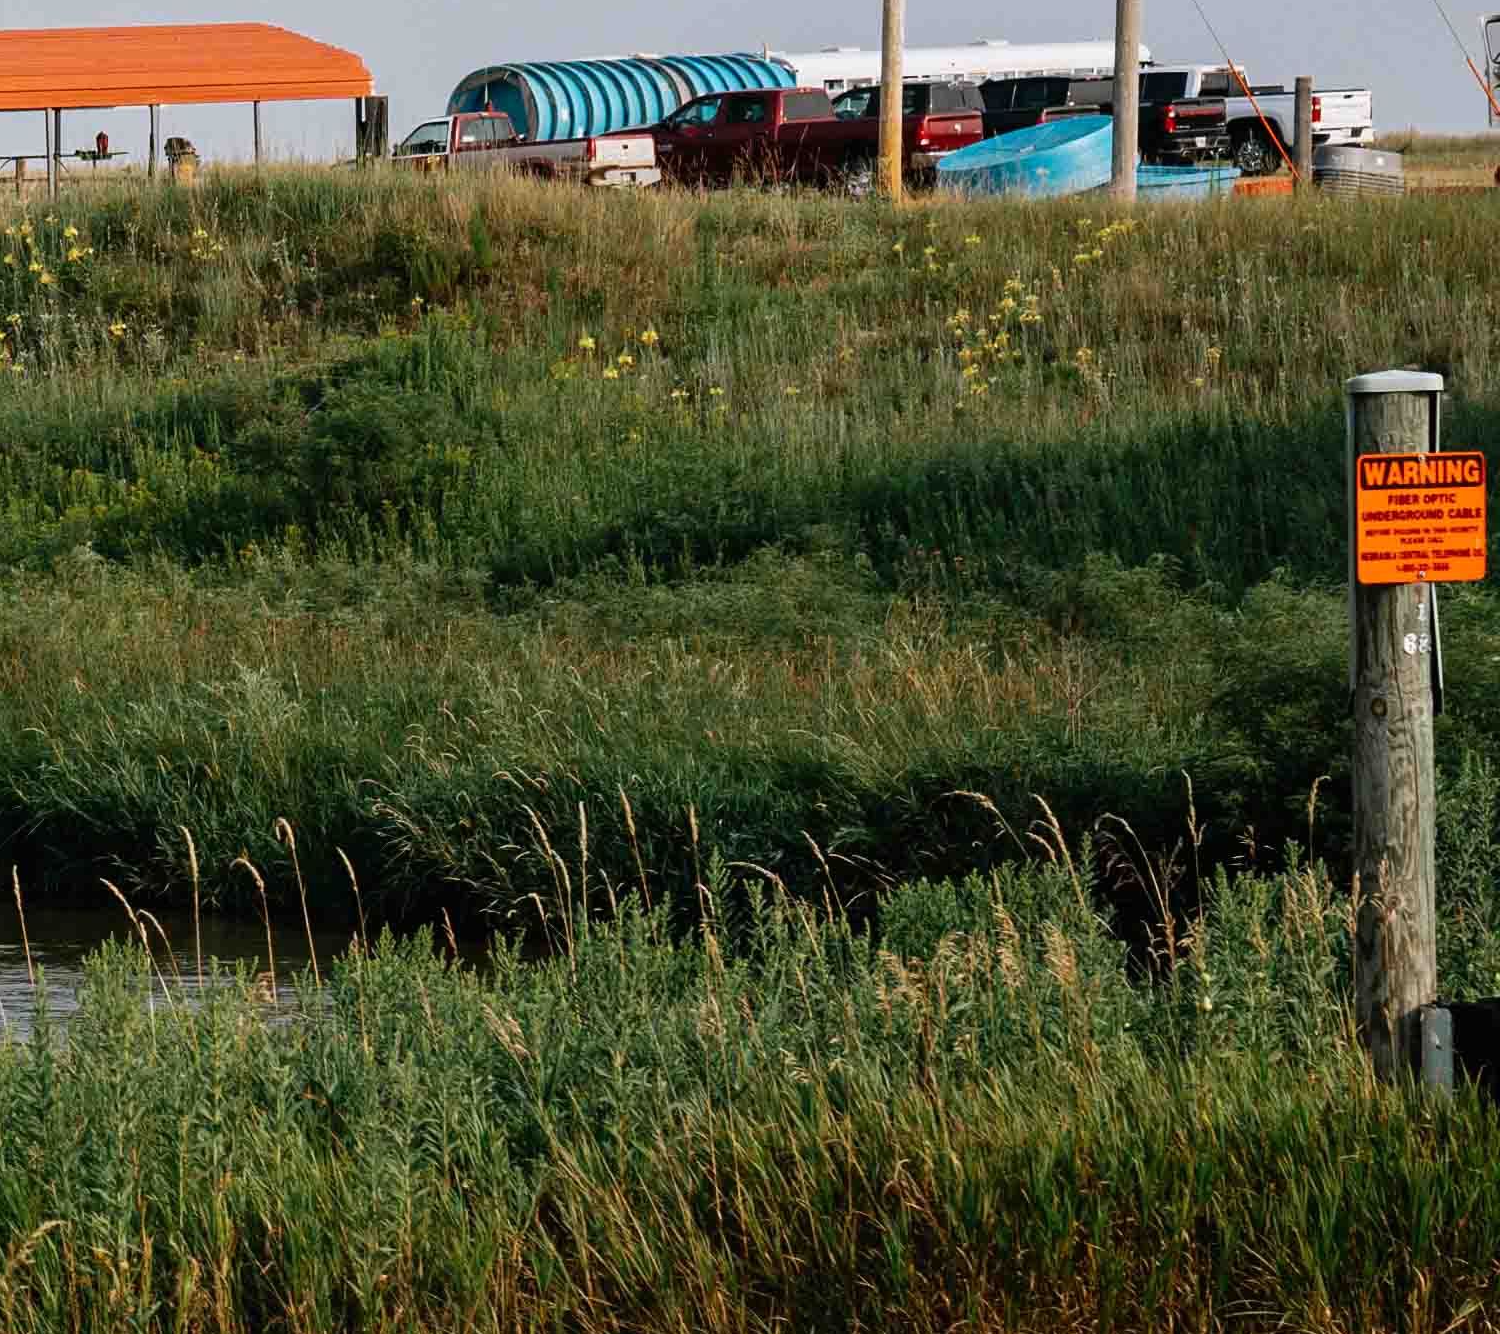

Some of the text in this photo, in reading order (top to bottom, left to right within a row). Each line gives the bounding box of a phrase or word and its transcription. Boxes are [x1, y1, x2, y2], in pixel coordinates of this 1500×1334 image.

[1363, 458, 1481, 486] WARNING
[1387, 492, 1457, 506] FIBER OPTIC
[1361, 507, 1483, 522] UNDERGROUND CABLE
